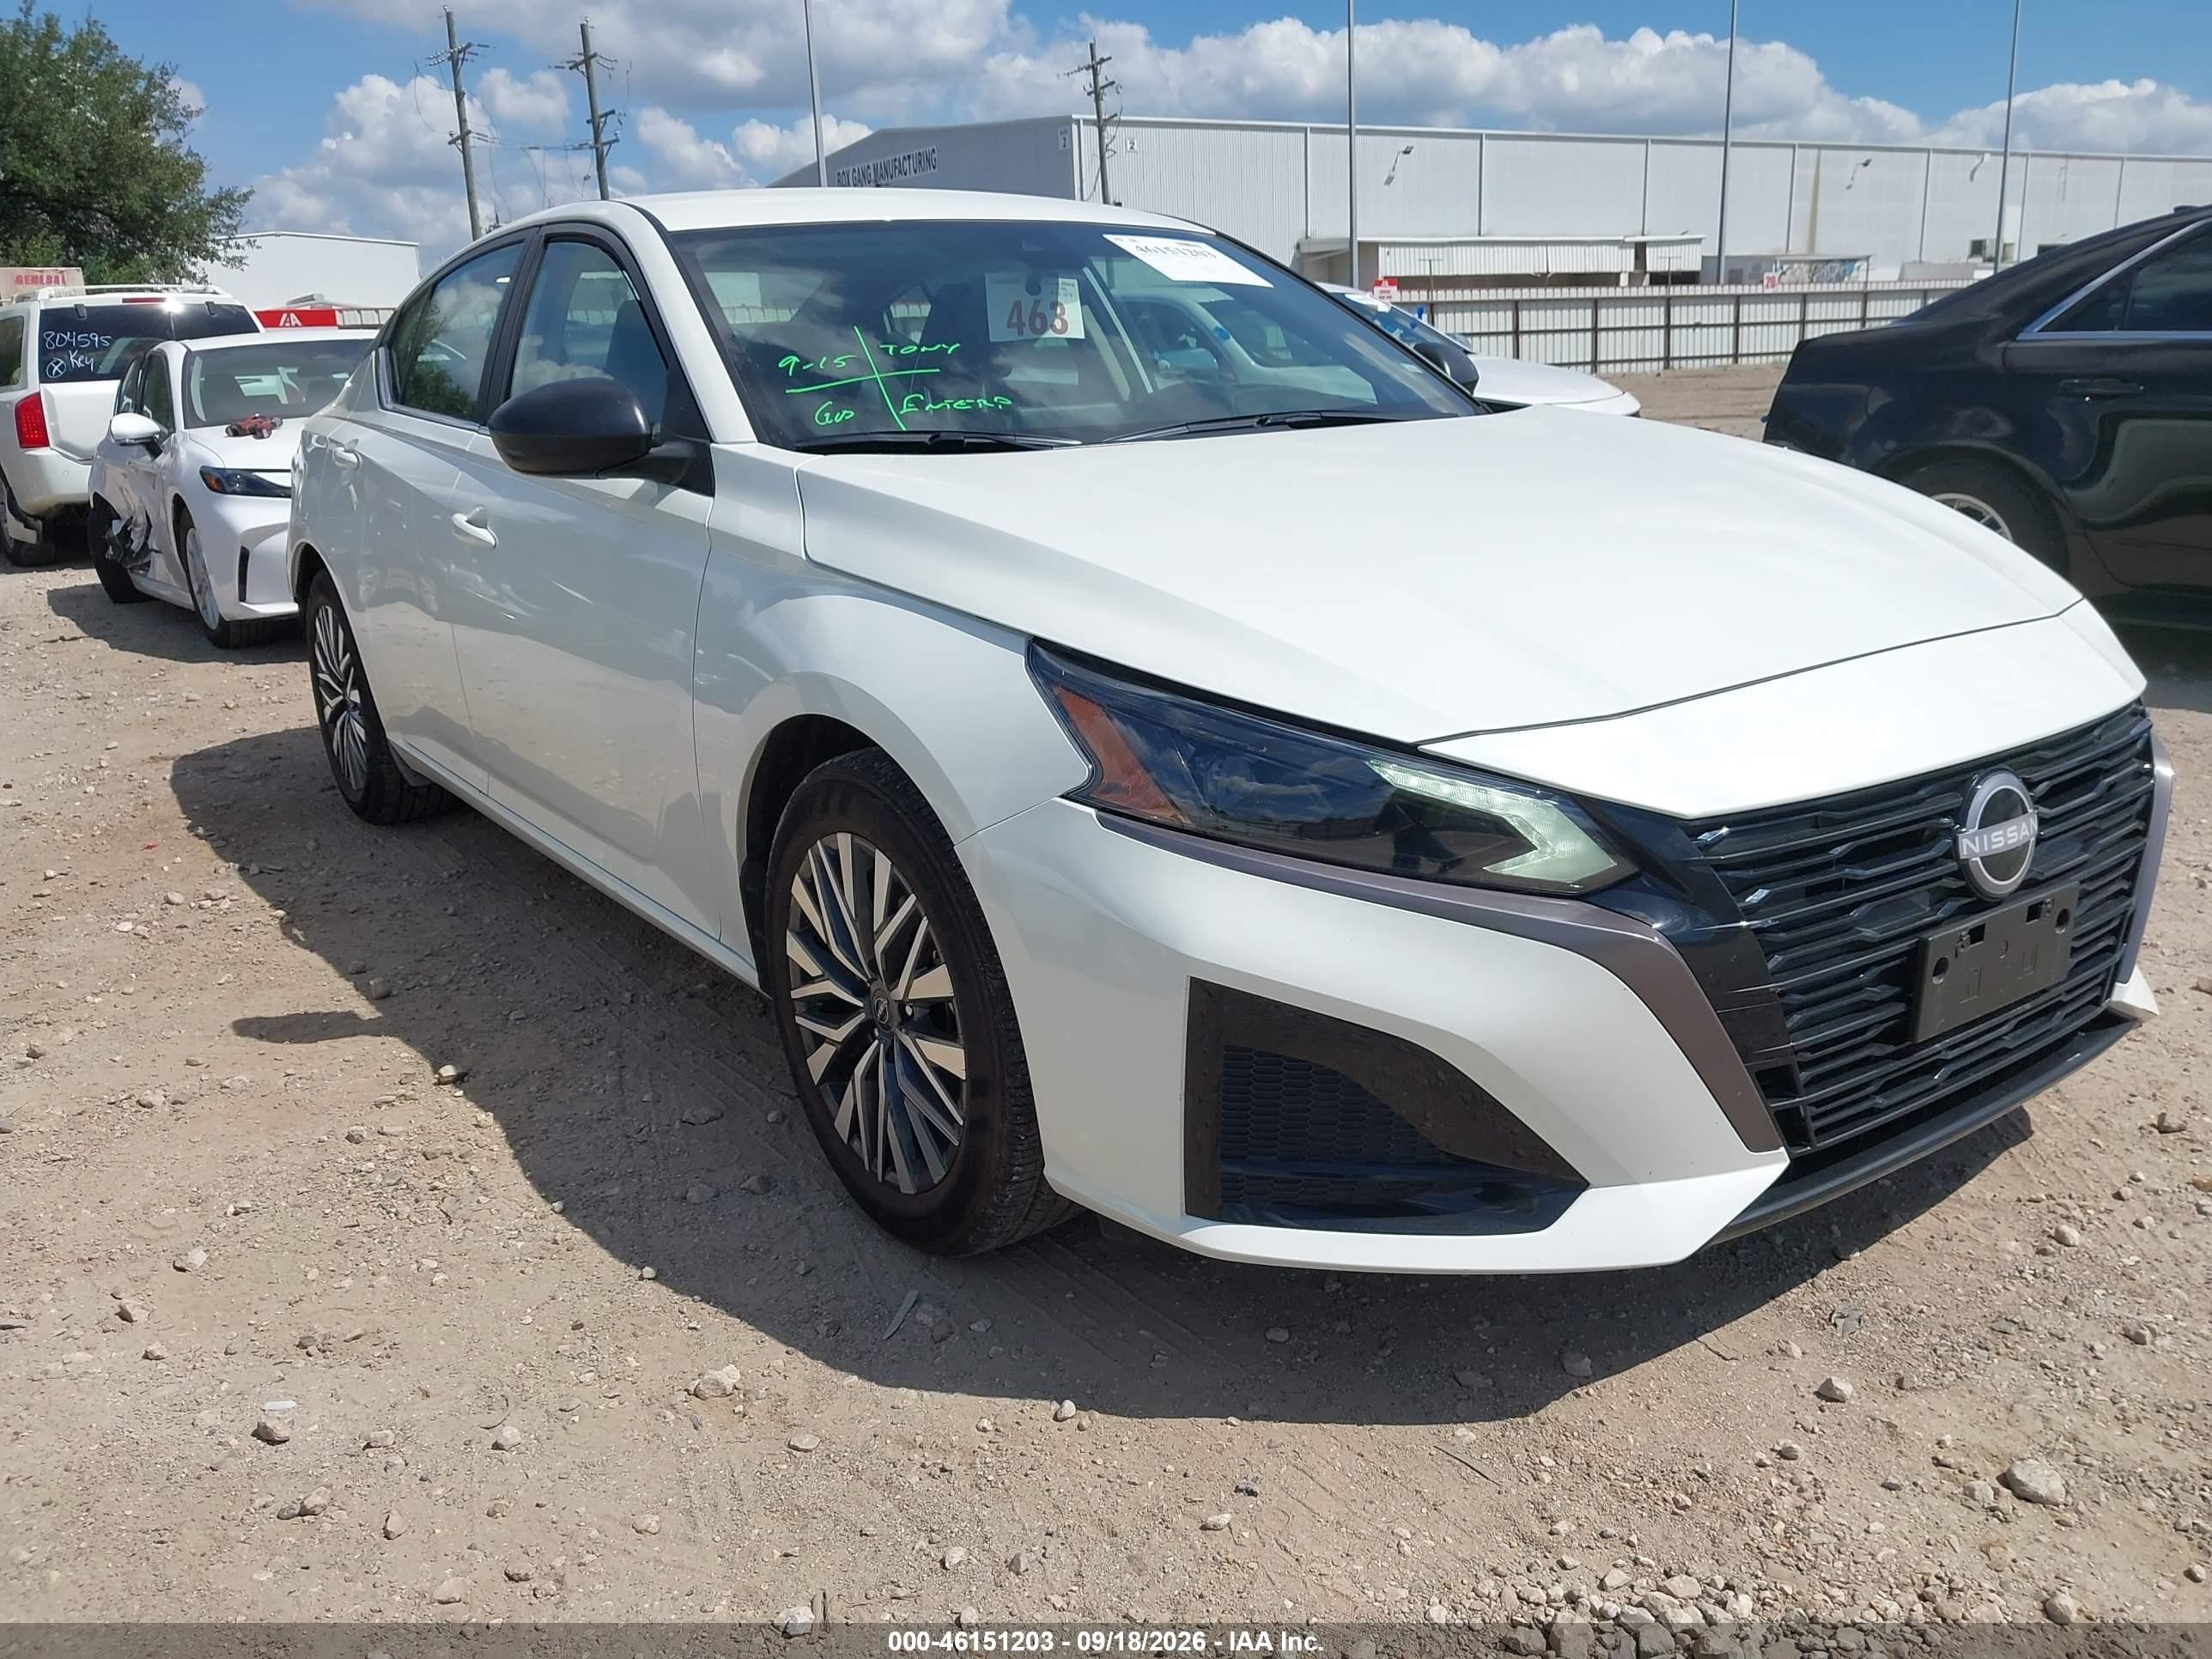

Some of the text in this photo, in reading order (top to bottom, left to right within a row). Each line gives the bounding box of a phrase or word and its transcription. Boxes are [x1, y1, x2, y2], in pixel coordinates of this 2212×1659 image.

[1128, 141, 1136, 151] 2
[852, 163, 872, 187] GANG
[872, 147, 938, 185] MANUFACTURING
[1006, 299, 1069, 337] 463
[43, 331, 112, 350] 804595
[68, 349, 95, 372] Key
[777, 355, 859, 376] 9-15
[1961, 817, 2039, 855] NISSAN
